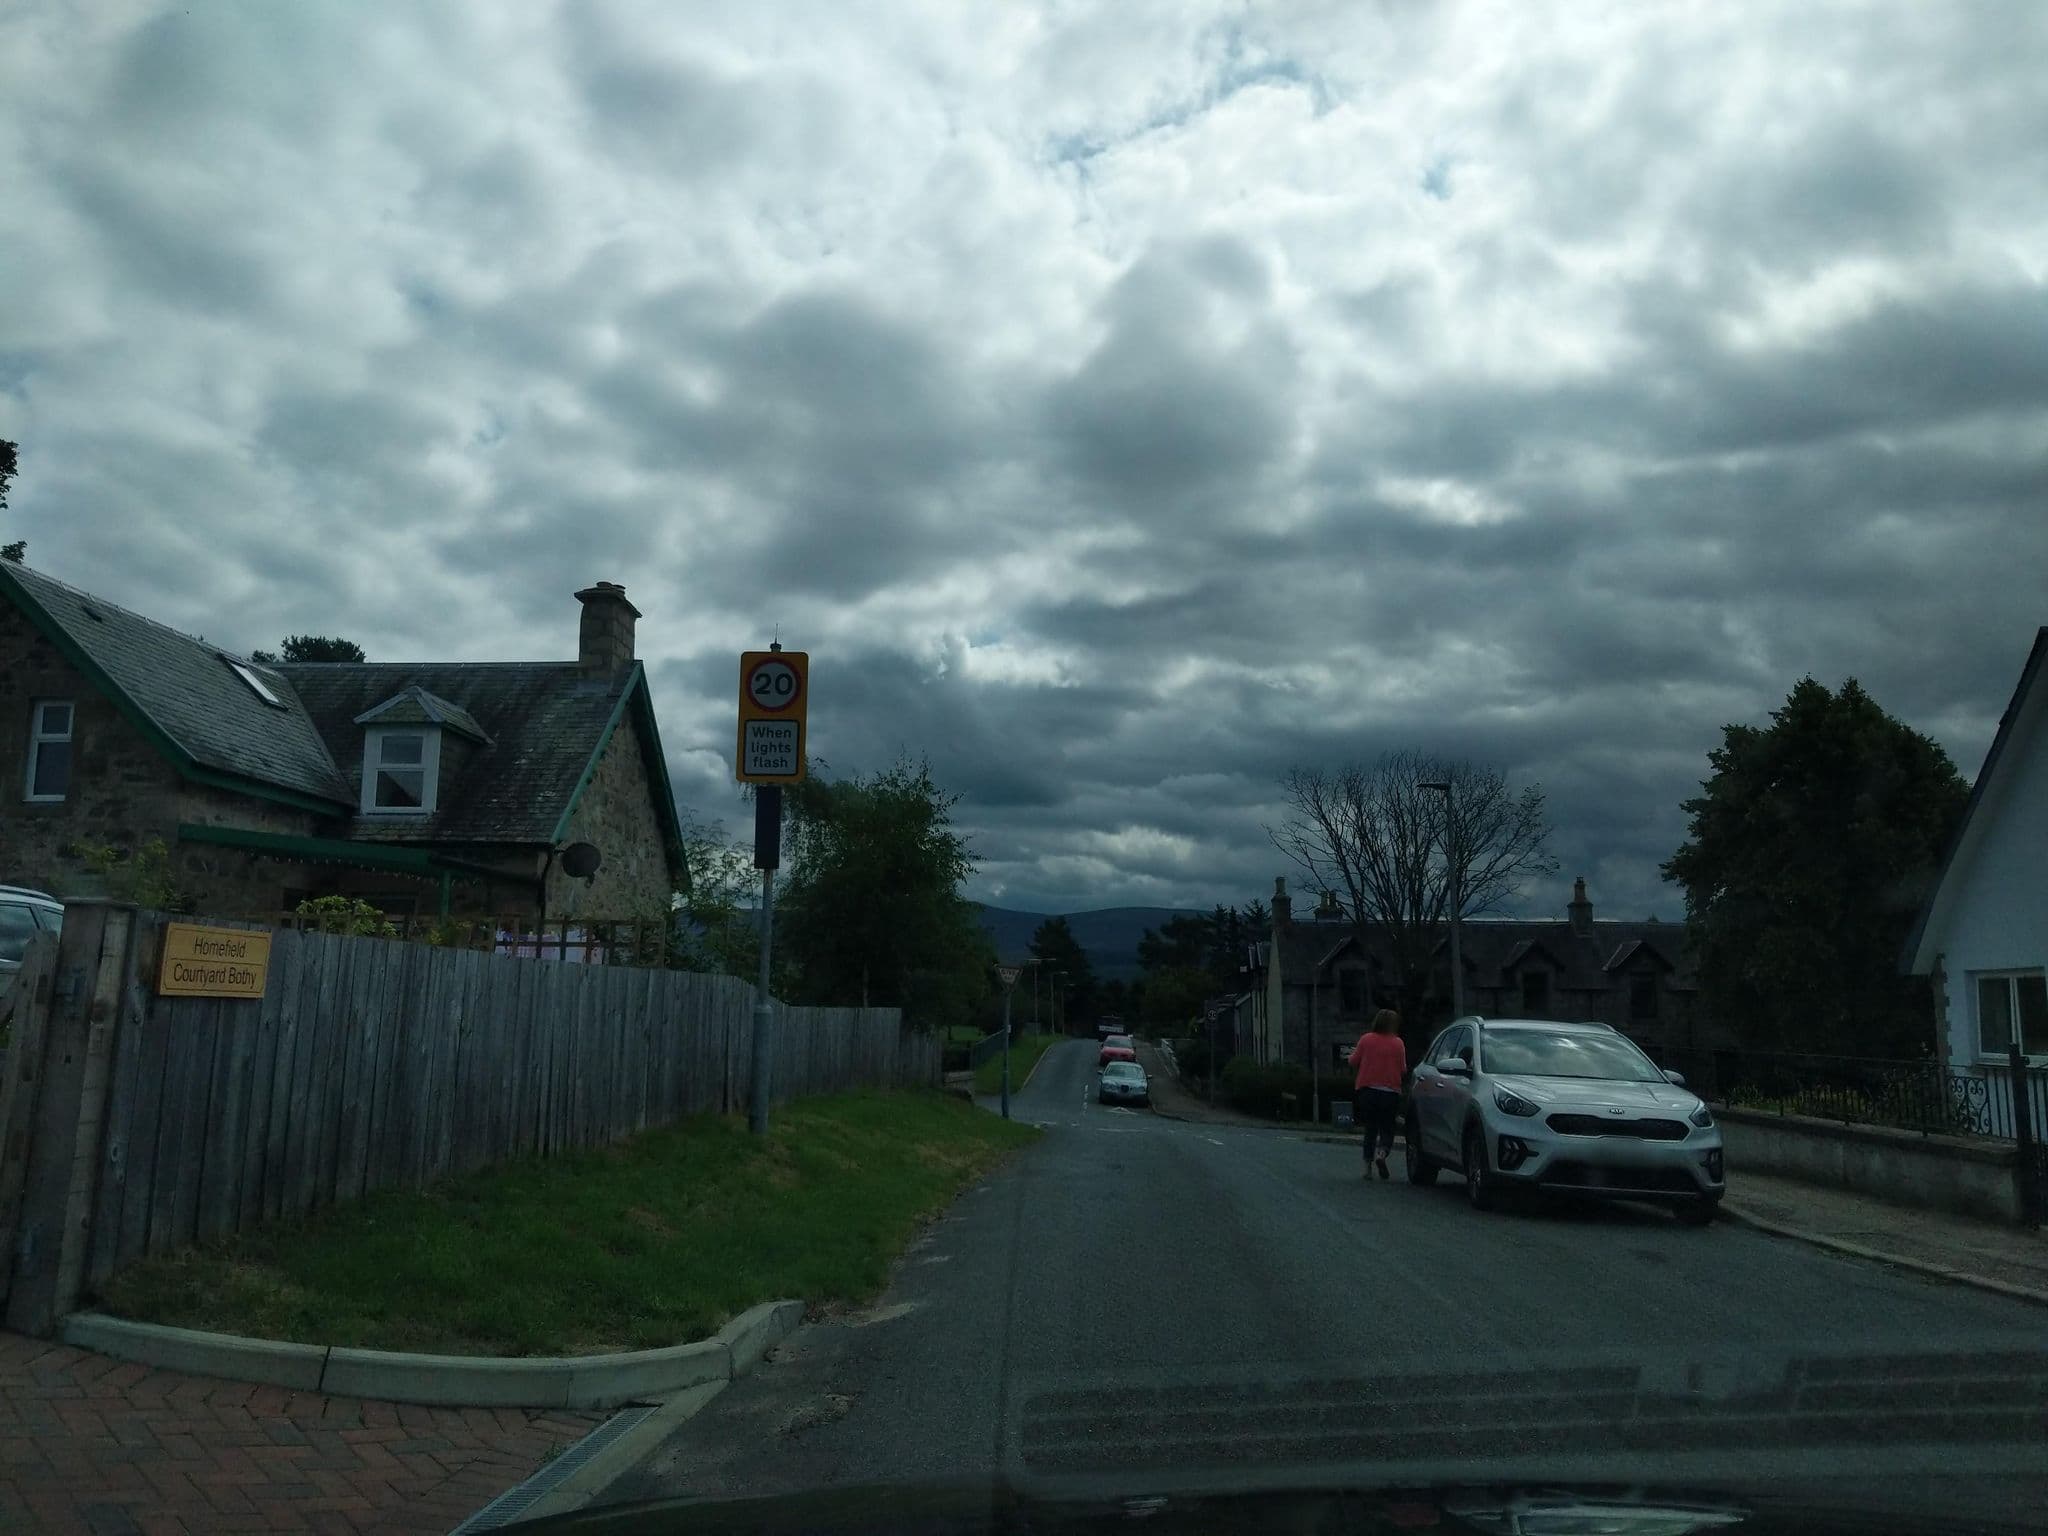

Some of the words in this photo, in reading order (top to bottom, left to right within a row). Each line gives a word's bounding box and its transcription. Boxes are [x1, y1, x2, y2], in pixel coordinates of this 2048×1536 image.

[755, 673, 792, 695] 20
[752, 727, 791, 738] When
[751, 741, 791, 755] lights
[752, 756, 788, 768] flash
[194, 936, 247, 958] Homefield
[173, 963, 226, 987] Courtyard
[228, 966, 257, 989] Bothy
